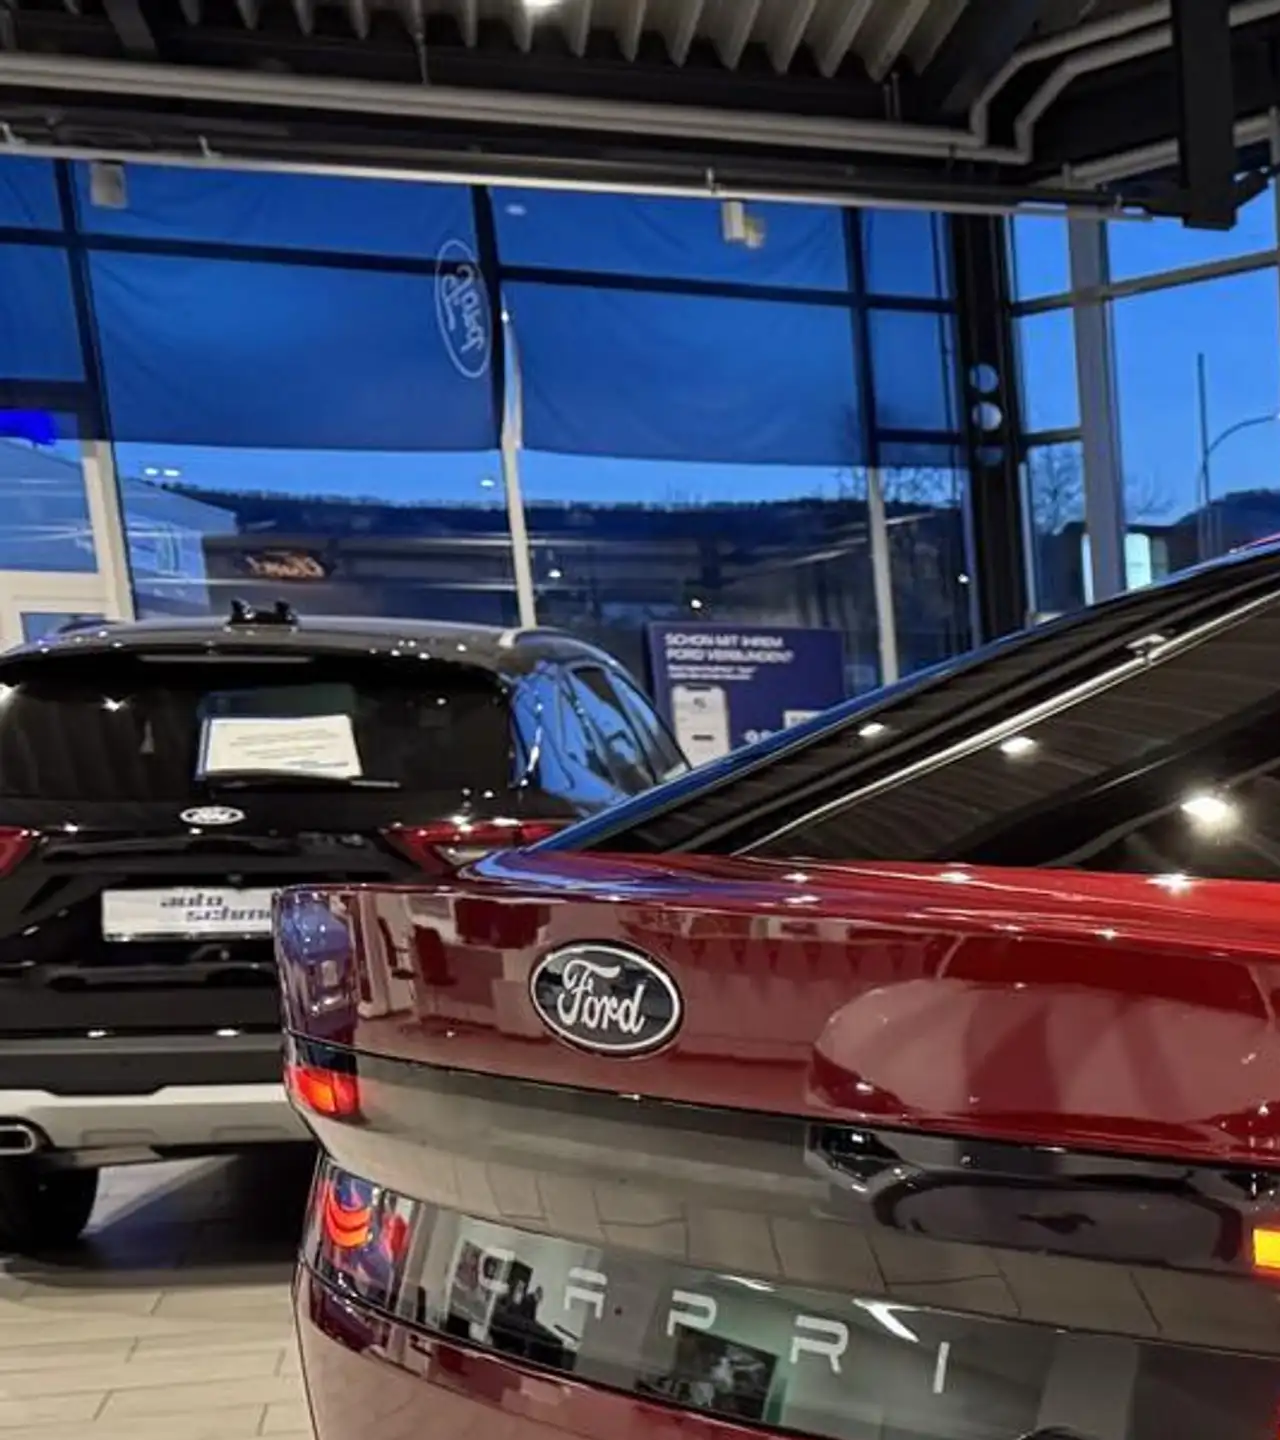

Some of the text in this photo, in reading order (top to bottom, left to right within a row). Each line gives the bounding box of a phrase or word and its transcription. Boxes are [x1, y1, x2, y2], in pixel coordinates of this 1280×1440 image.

[186, 906, 272, 921] schm
[556, 959, 648, 1035] Ford
[478, 1246, 952, 1395] CAPRI
